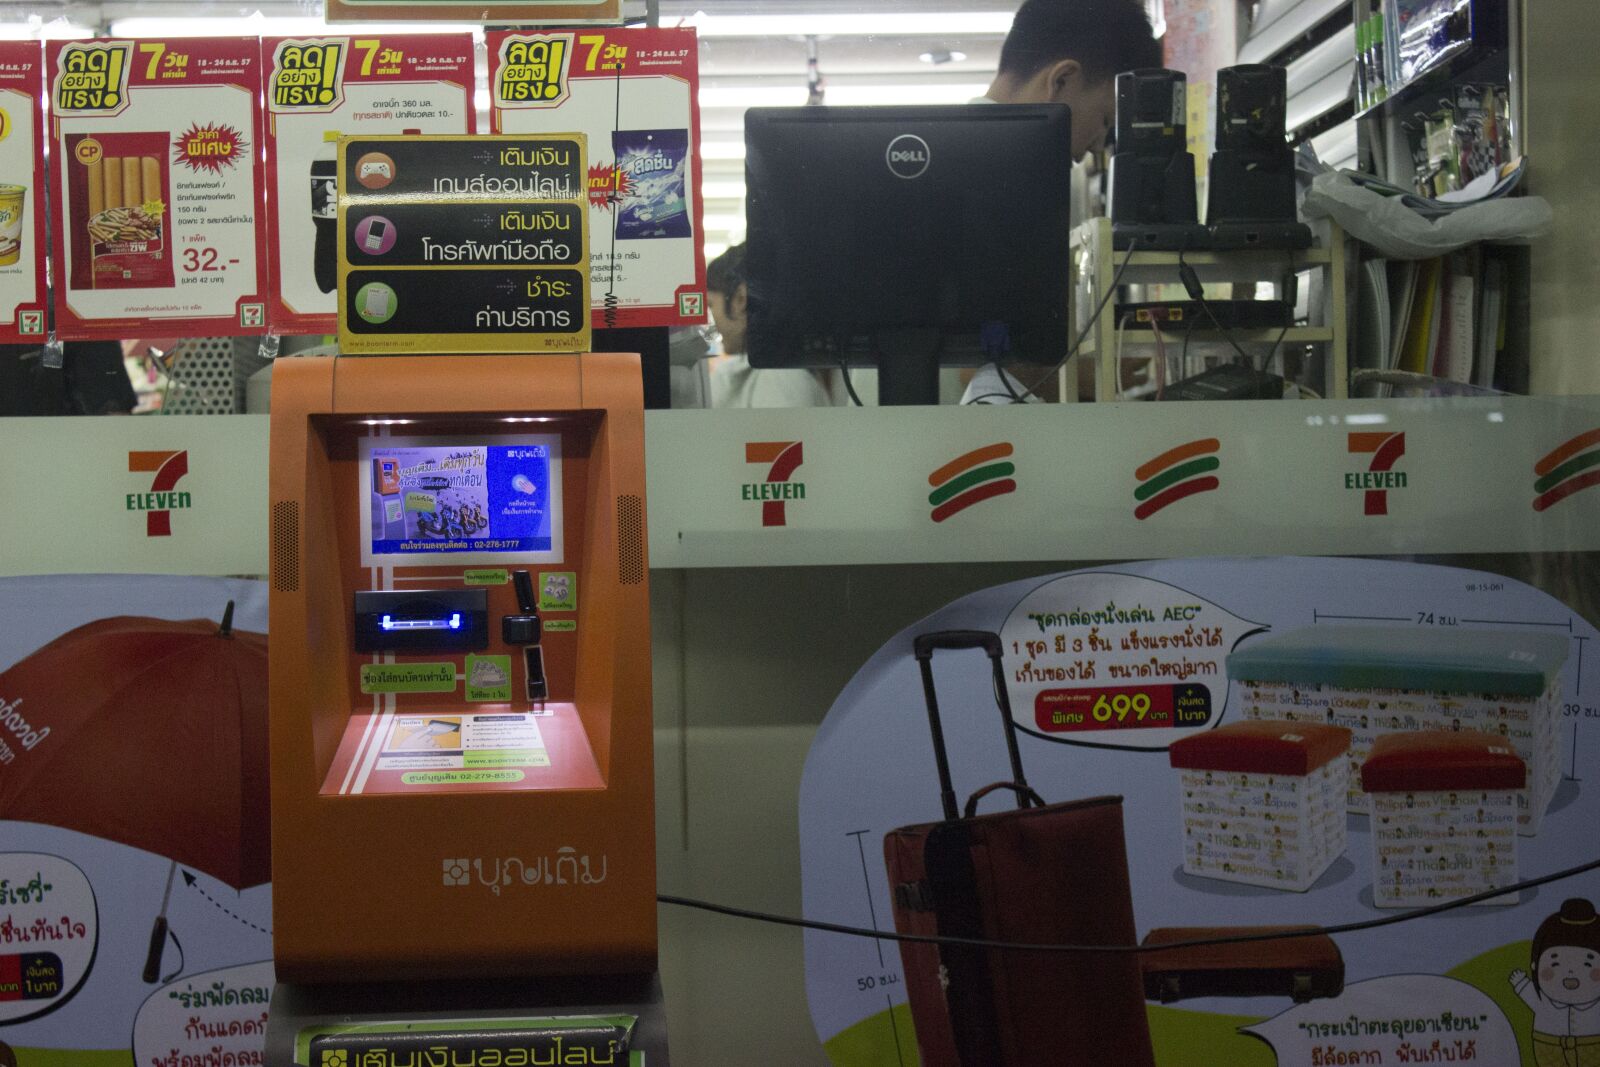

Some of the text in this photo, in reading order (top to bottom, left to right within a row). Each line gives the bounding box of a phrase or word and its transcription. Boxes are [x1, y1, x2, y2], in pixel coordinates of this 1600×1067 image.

[68, 49, 107, 72] ลด
[140, 43, 189, 80] 7 วัน
[283, 47, 323, 68] ลด
[355, 40, 404, 76] 7 วัน
[509, 42, 548, 63] ลด
[579, 35, 628, 71] 7 วัน
[65, 72, 101, 87] อย่าง
[281, 71, 316, 84] อย่าง
[507, 65, 541, 79] อย่าง
[61, 90, 102, 109] แรง
[276, 88, 316, 104] แรง
[502, 82, 542, 100] แรง
[402, 100, 417, 108] 360
[197, 131, 219, 140] ราคา
[79, 147, 98, 157] CP
[187, 139, 232, 156] พิเศษ
[500, 147, 570, 167] เติมเงิน
[891, 150, 926, 162] DELL
[634, 149, 673, 175] สดชื่น
[434, 171, 571, 195] เกมส์ออนไลน์
[500, 211, 570, 231] เติมเงิน
[422, 236, 571, 261] โทรศัพท์มือถือ
[183, 248, 240, 272] 32.-
[199, 276, 208, 284] 42
[527, 275, 572, 297] ชำระ
[476, 305, 570, 328] ค่าบริการ
[1417, 612, 1434, 625] 74
[1012, 625, 1223, 660] 1 ชุด มี 3 ชิ้น แข็งแรงนั่งได้
[1016, 658, 1217, 682] เก็บของได้ ขนาดใหญ่มาก
[1052, 693, 1169, 725] พิเศษ 699 บาท
[1178, 695, 1205, 706] เงินสด
[1563, 704, 1580, 717] 39
[473, 846, 608, 897] บุญเติม
[0, 913, 86, 943] ชื่นทันใจ
[27, 967, 56, 978] เงินสด
[857, 976, 875, 991] 50
[1311, 1039, 1476, 1067] มีล้อลาก พับเก็บได้
